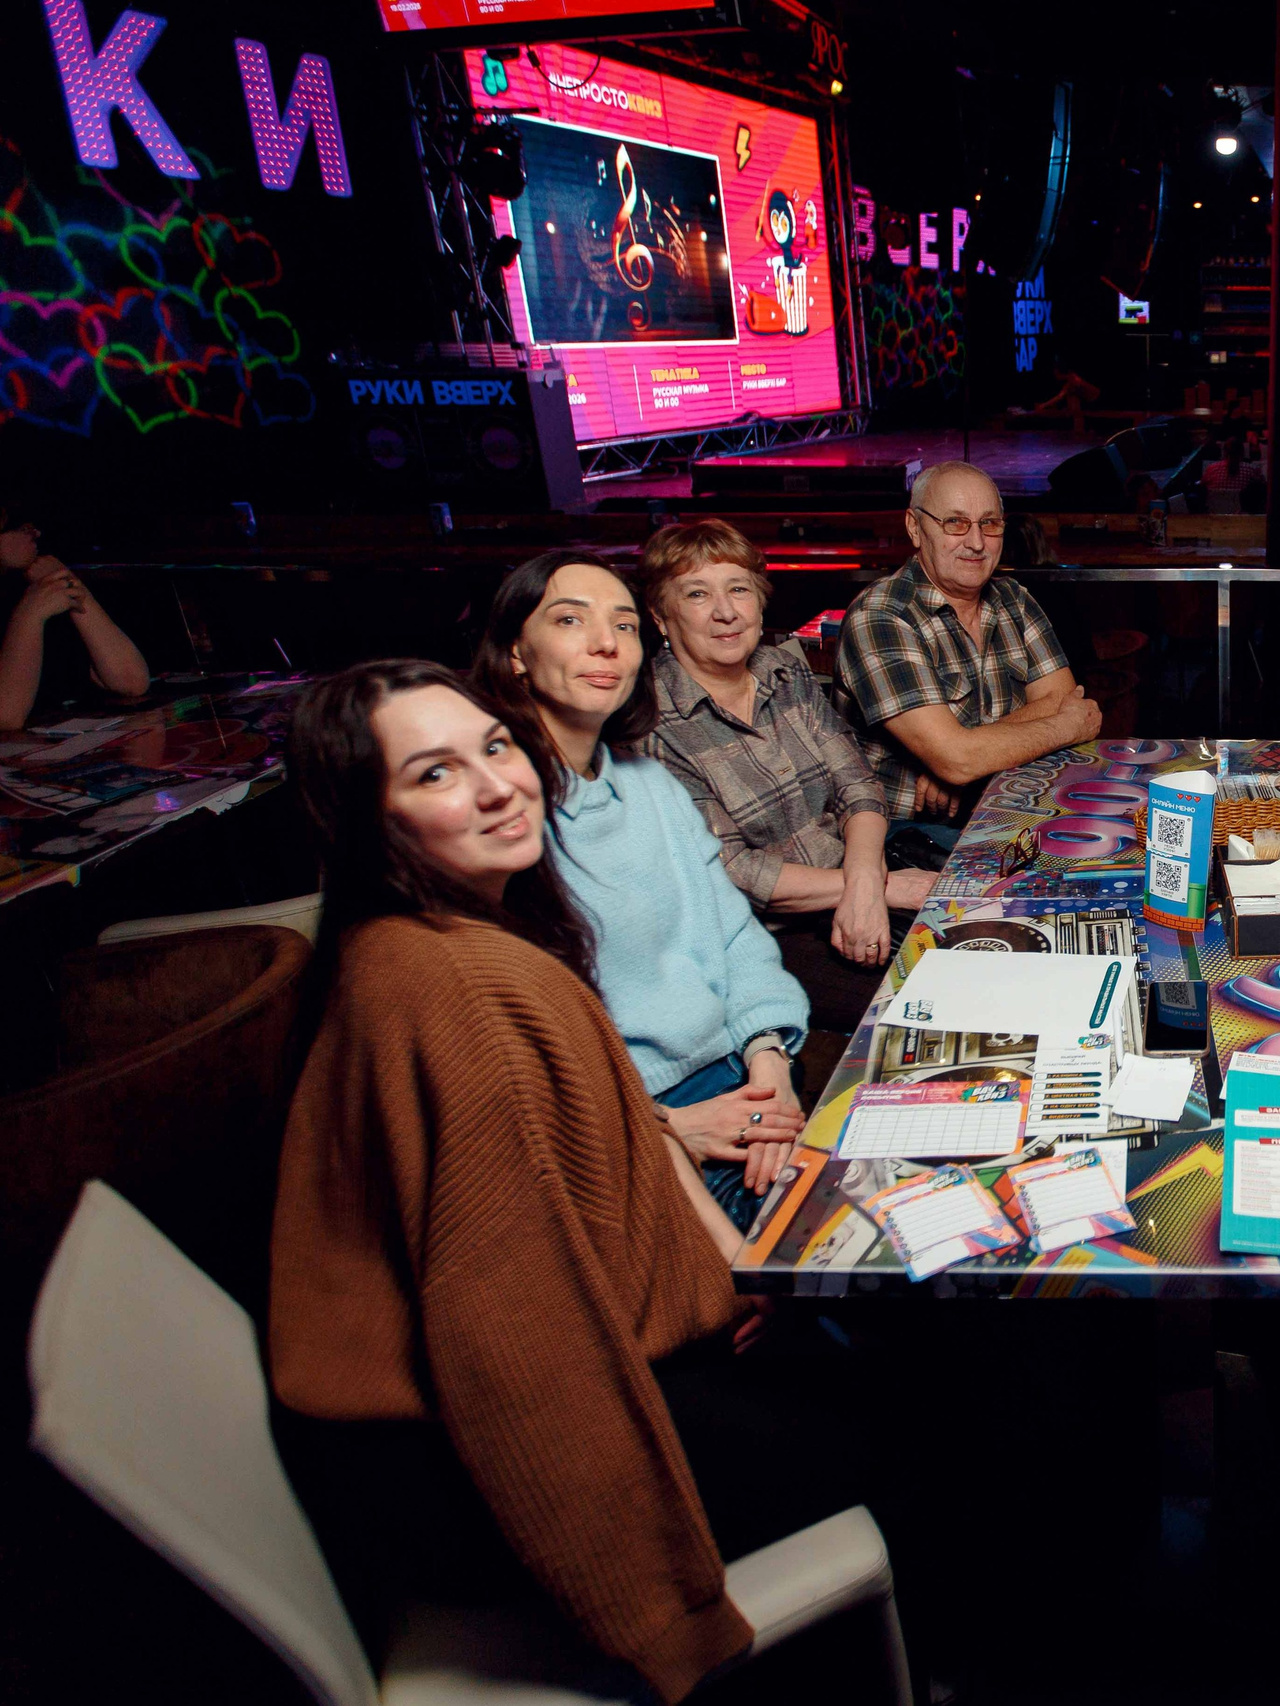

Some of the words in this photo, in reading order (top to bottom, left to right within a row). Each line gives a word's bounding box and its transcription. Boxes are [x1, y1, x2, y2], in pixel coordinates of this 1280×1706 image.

[650, 366, 700, 382] ТЕМАТИКА
[348, 379, 425, 405] РУКИ
[652, 386, 682, 398] РУССКАЯ
[1151, 797, 1175, 810] ОНЛАЙН
[1175, 804, 1196, 814] МЕНЮ
[972, 1085, 998, 1096] ВАУ
[976, 1090, 1007, 1102] КВИЗ
